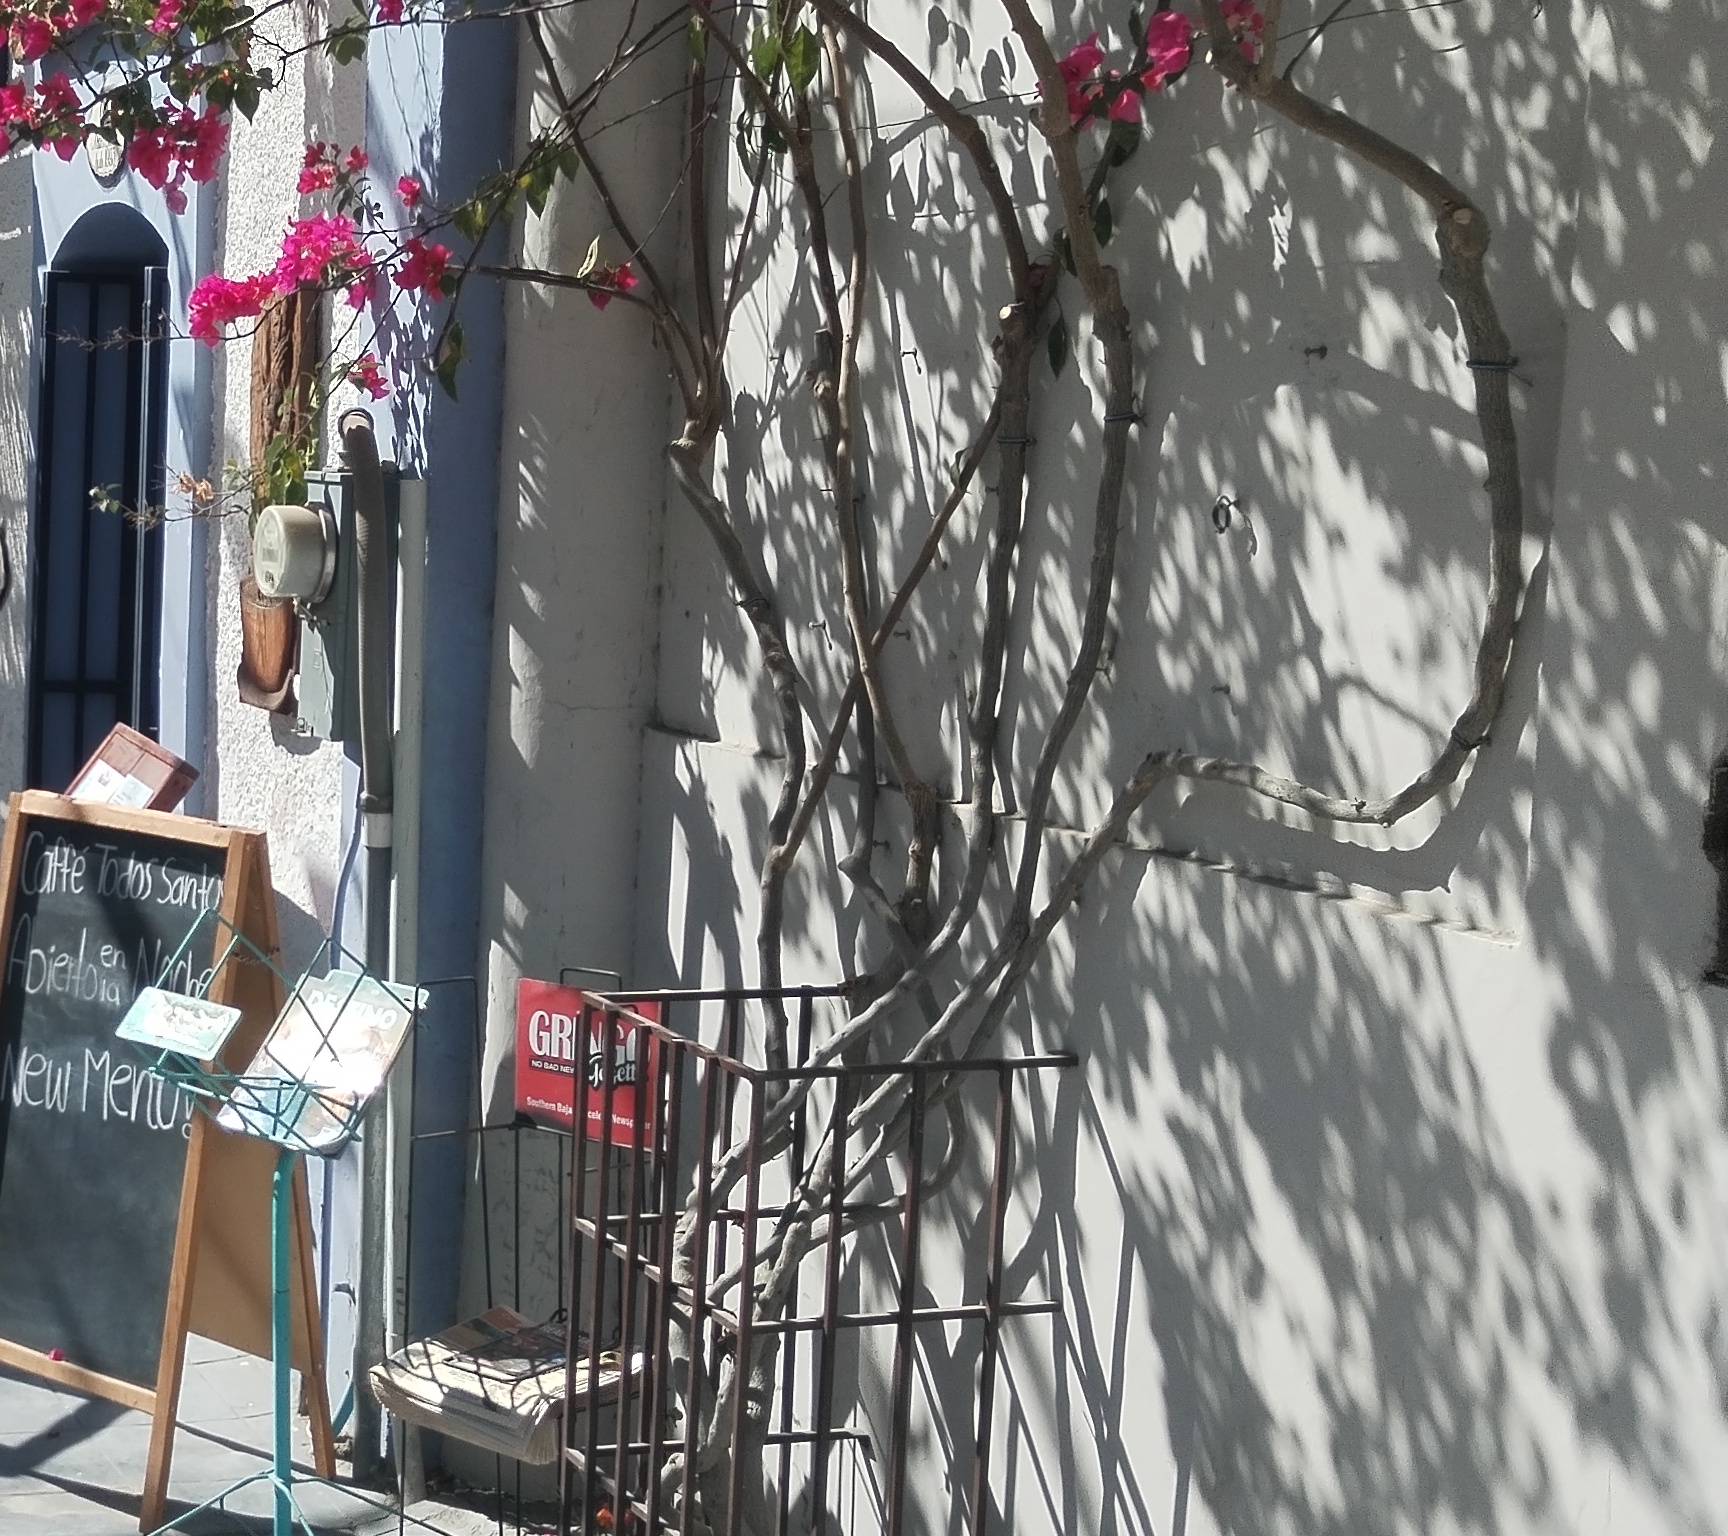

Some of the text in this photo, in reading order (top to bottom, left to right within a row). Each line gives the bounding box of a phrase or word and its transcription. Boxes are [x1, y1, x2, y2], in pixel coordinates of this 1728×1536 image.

[95, 843, 160, 901] Todos
[7, 912, 98, 1001] Abierto
[100, 944, 127, 970] en
[306, 989, 398, 1031] DEINO
[0, 1043, 71, 1113] New
[531, 1059, 575, 1075] NO BAD NEW
